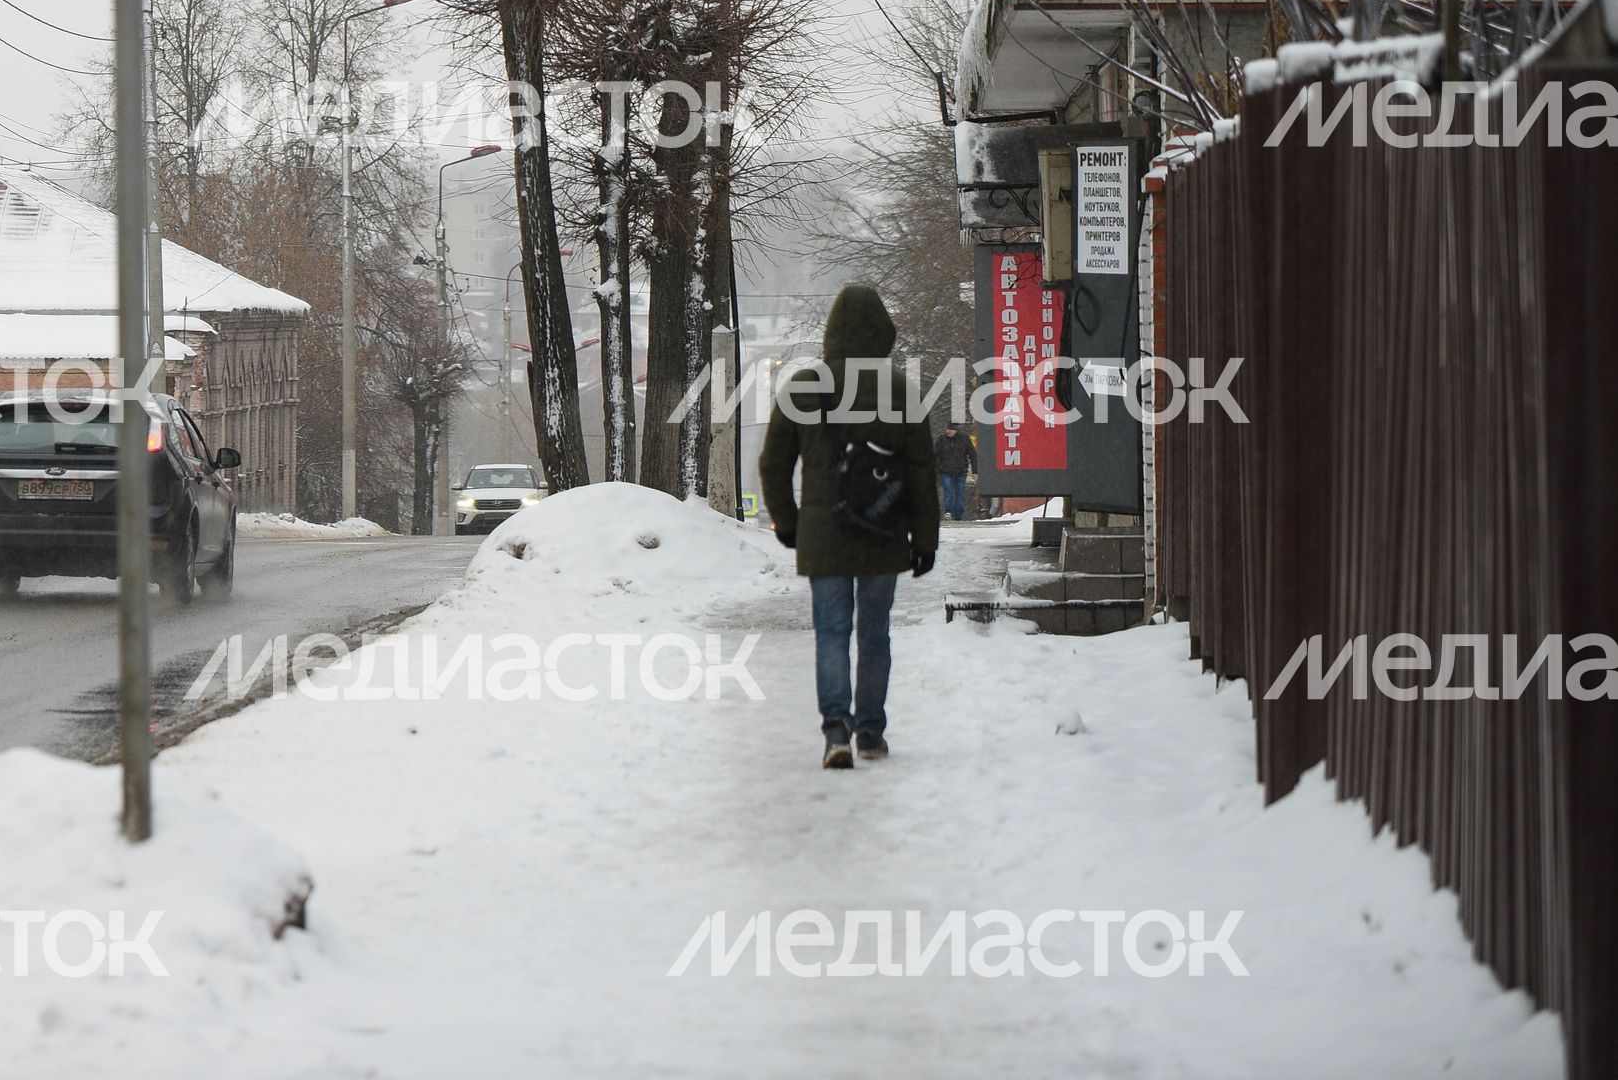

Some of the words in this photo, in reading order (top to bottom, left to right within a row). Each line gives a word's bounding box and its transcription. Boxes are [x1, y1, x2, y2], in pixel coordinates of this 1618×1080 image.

[1079, 152, 1127, 167] РЕМОНТ:
[1084, 172, 1122, 184] ТЕЛЕФОНОВ,
[1083, 187, 1123, 198] ПЛАНШЕТОВ,
[1084, 201, 1121, 213] НОУТБУКОВ,
[1079, 216, 1126, 228] КОМПЬЮТЕРОВ,
[1085, 231, 1121, 241] ПРИНТЕРОВ
[1090, 245, 1115, 256] ПРОДАЖА
[1085, 259, 1120, 269] АКСЕССУАРОВ
[1000, 255, 1021, 466] АВТОЗАПЧАСТИ
[1022, 334, 1037, 385] ДЛЯ
[1041, 289, 1055, 429] ИНОМАРОК
